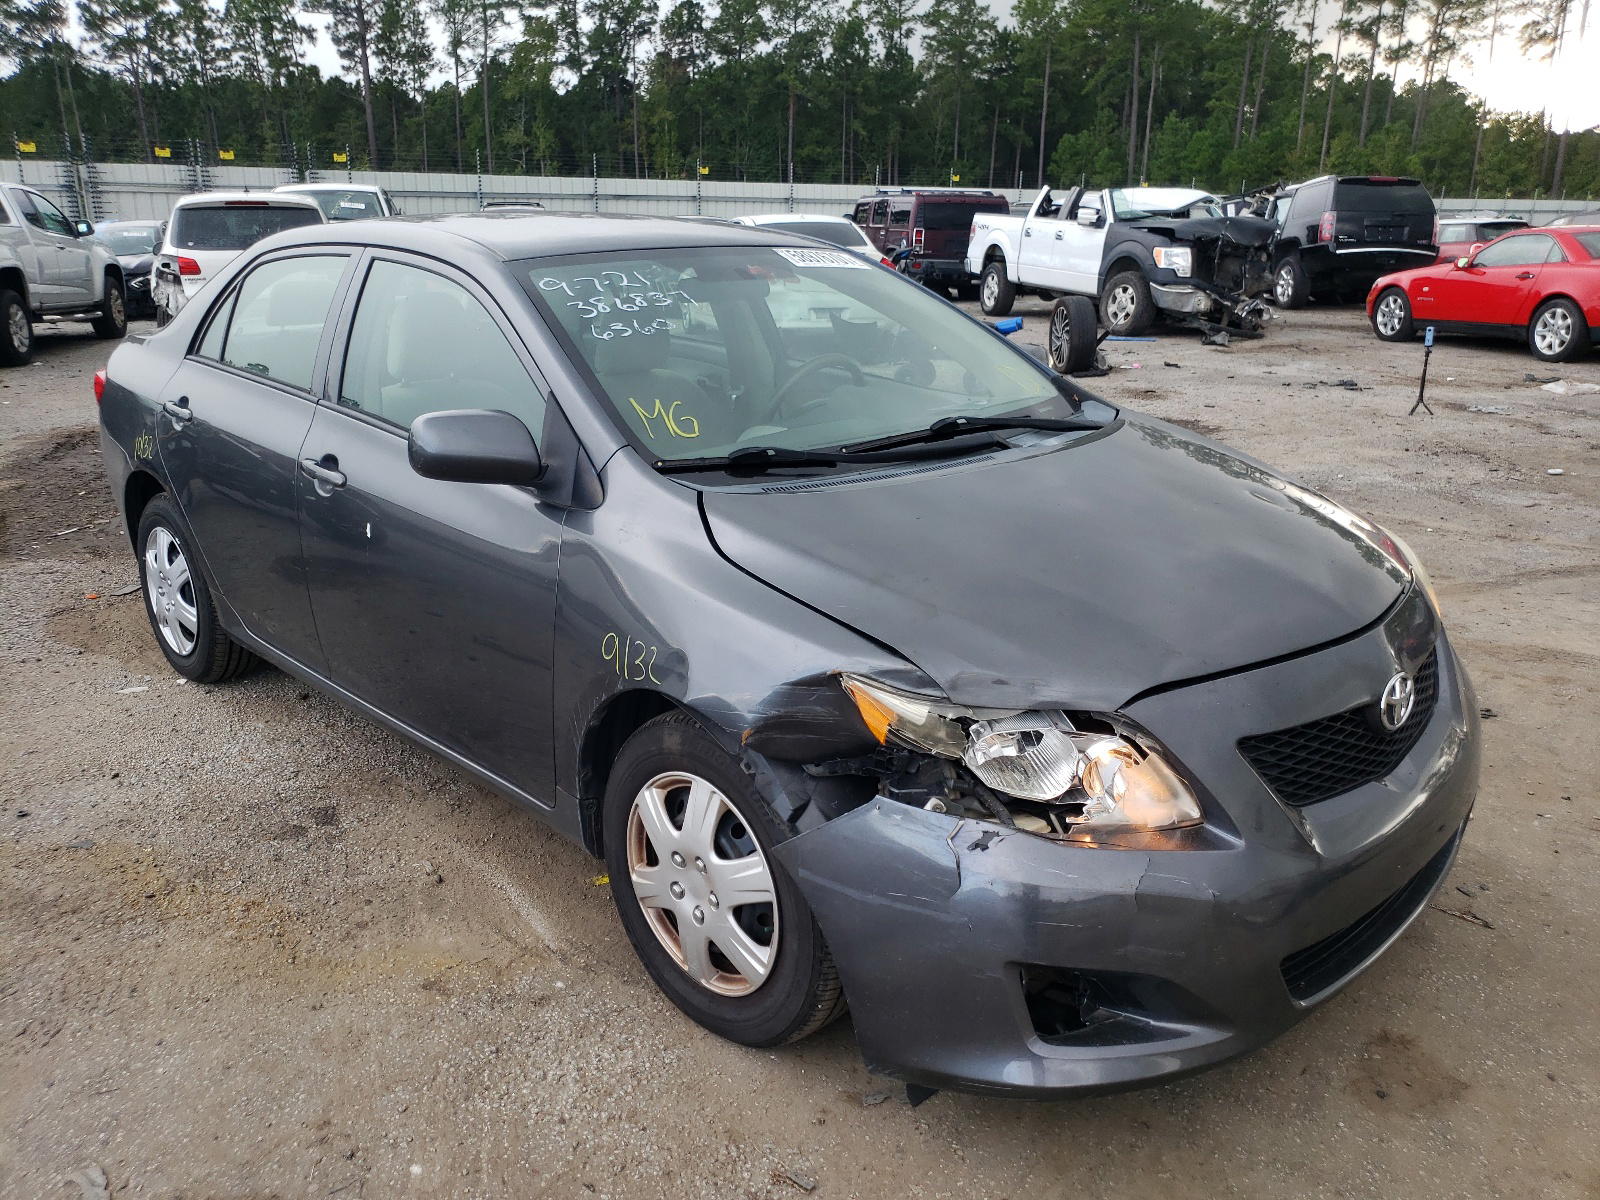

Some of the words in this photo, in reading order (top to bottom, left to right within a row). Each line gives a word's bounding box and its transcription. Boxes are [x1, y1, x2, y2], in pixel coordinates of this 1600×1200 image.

[538, 271, 651, 297] 9-7-21
[628, 397, 700, 440] MG
[601, 632, 662, 685] 9132
